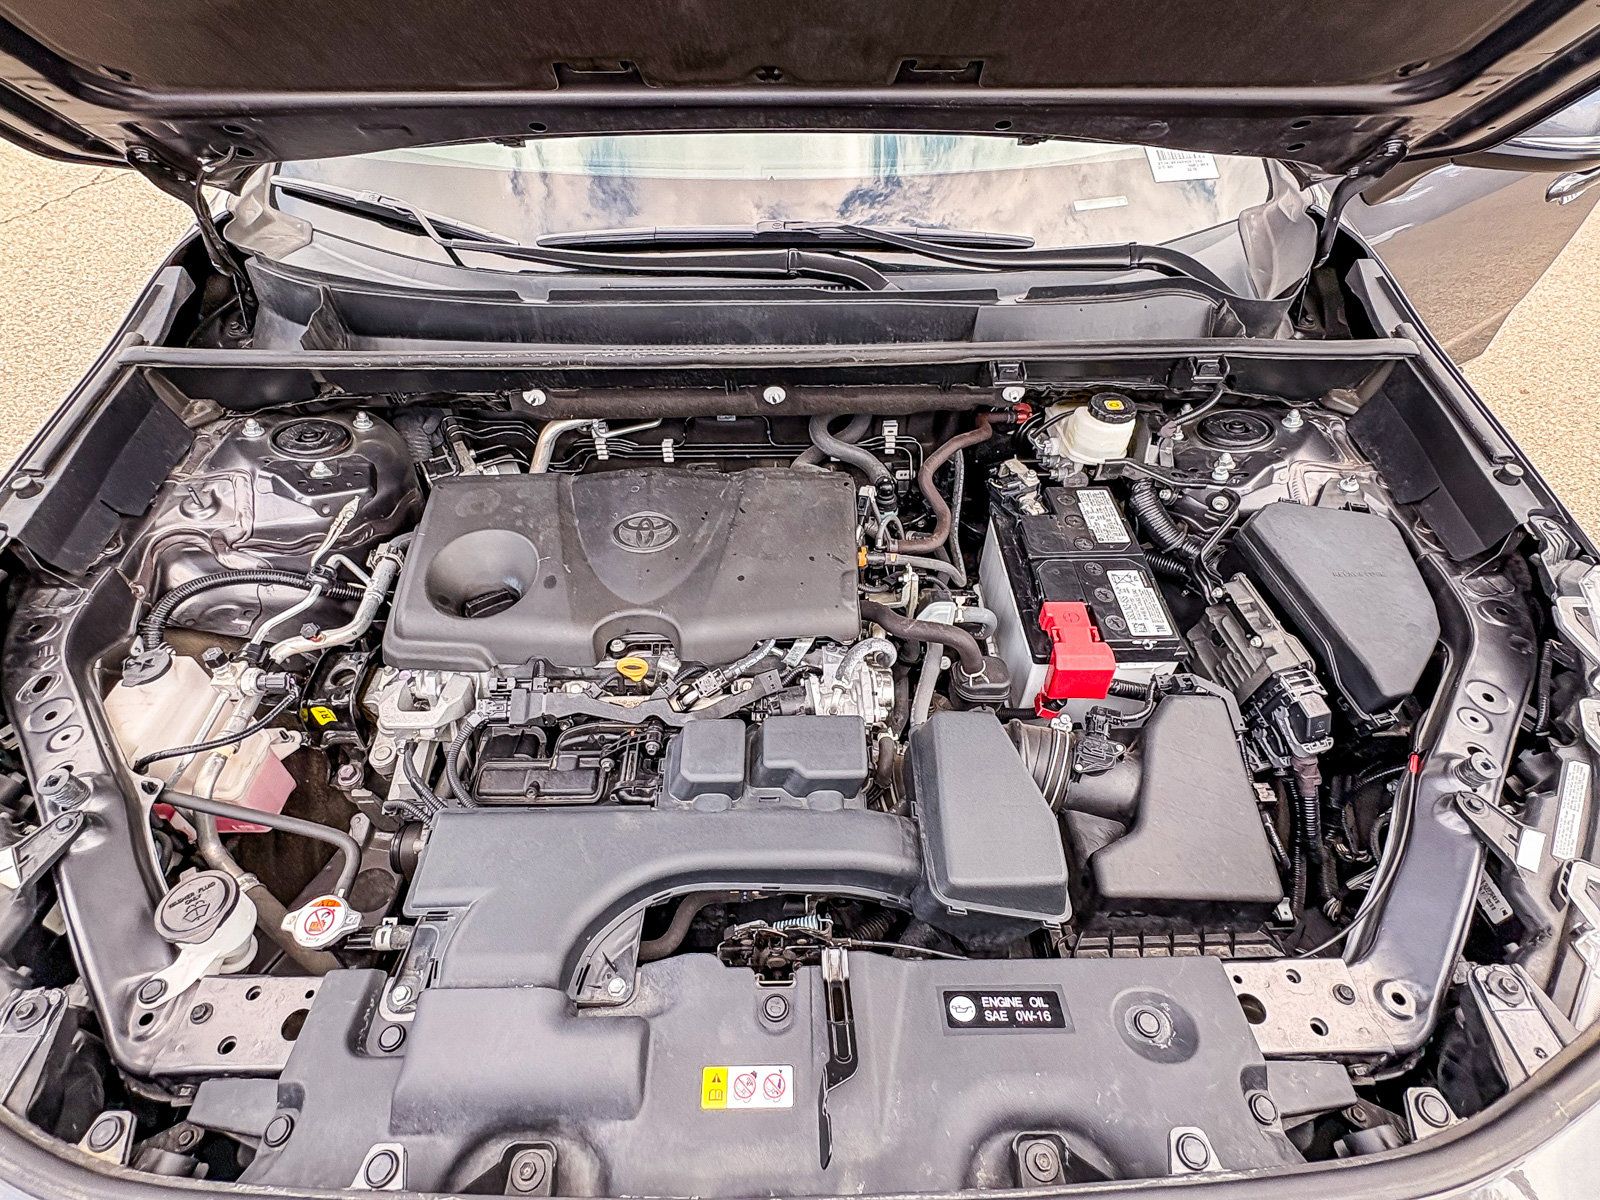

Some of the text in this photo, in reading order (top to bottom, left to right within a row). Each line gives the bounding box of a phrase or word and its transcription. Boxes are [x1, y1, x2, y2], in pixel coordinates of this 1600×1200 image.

[981, 996, 1049, 1008] ENGINE OIL
[984, 1010, 1052, 1022] SAE 0W-16
